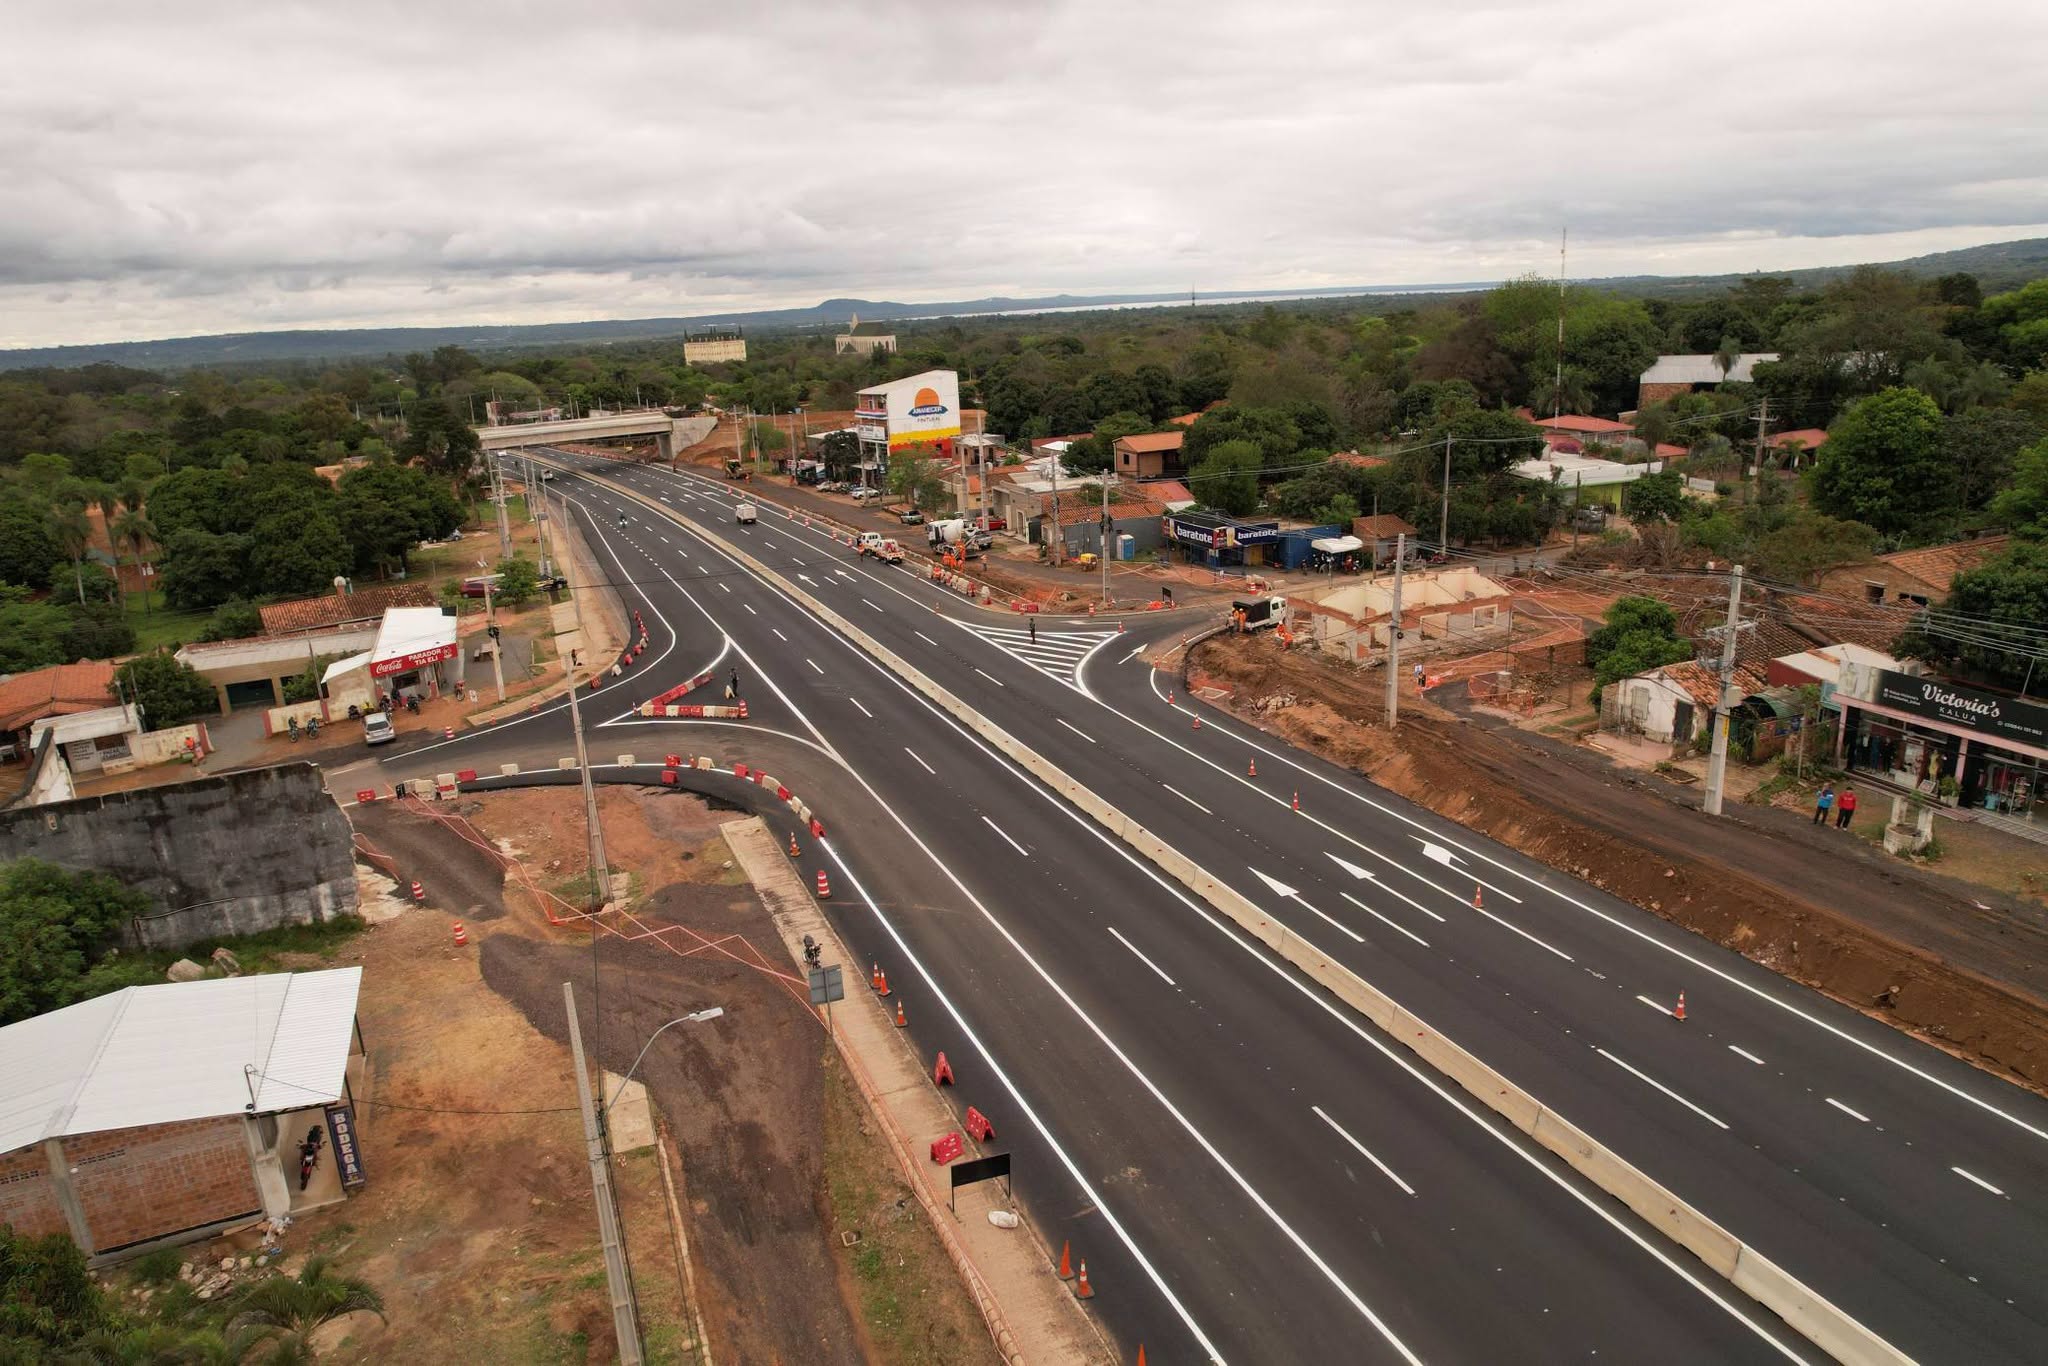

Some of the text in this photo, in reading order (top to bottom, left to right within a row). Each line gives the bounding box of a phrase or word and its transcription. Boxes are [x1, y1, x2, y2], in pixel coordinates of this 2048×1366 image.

[1177, 526, 1212, 544] baratote
[1238, 529, 1277, 540] baratote
[408, 649, 441, 662] PARADOR
[428, 655, 438, 663] ELI
[376, 660, 403, 674] Coca-Cola
[1922, 684, 2000, 718] Victoria's
[1940, 707, 1976, 721] KALUA
[334, 1113, 358, 1174] BODEGA
